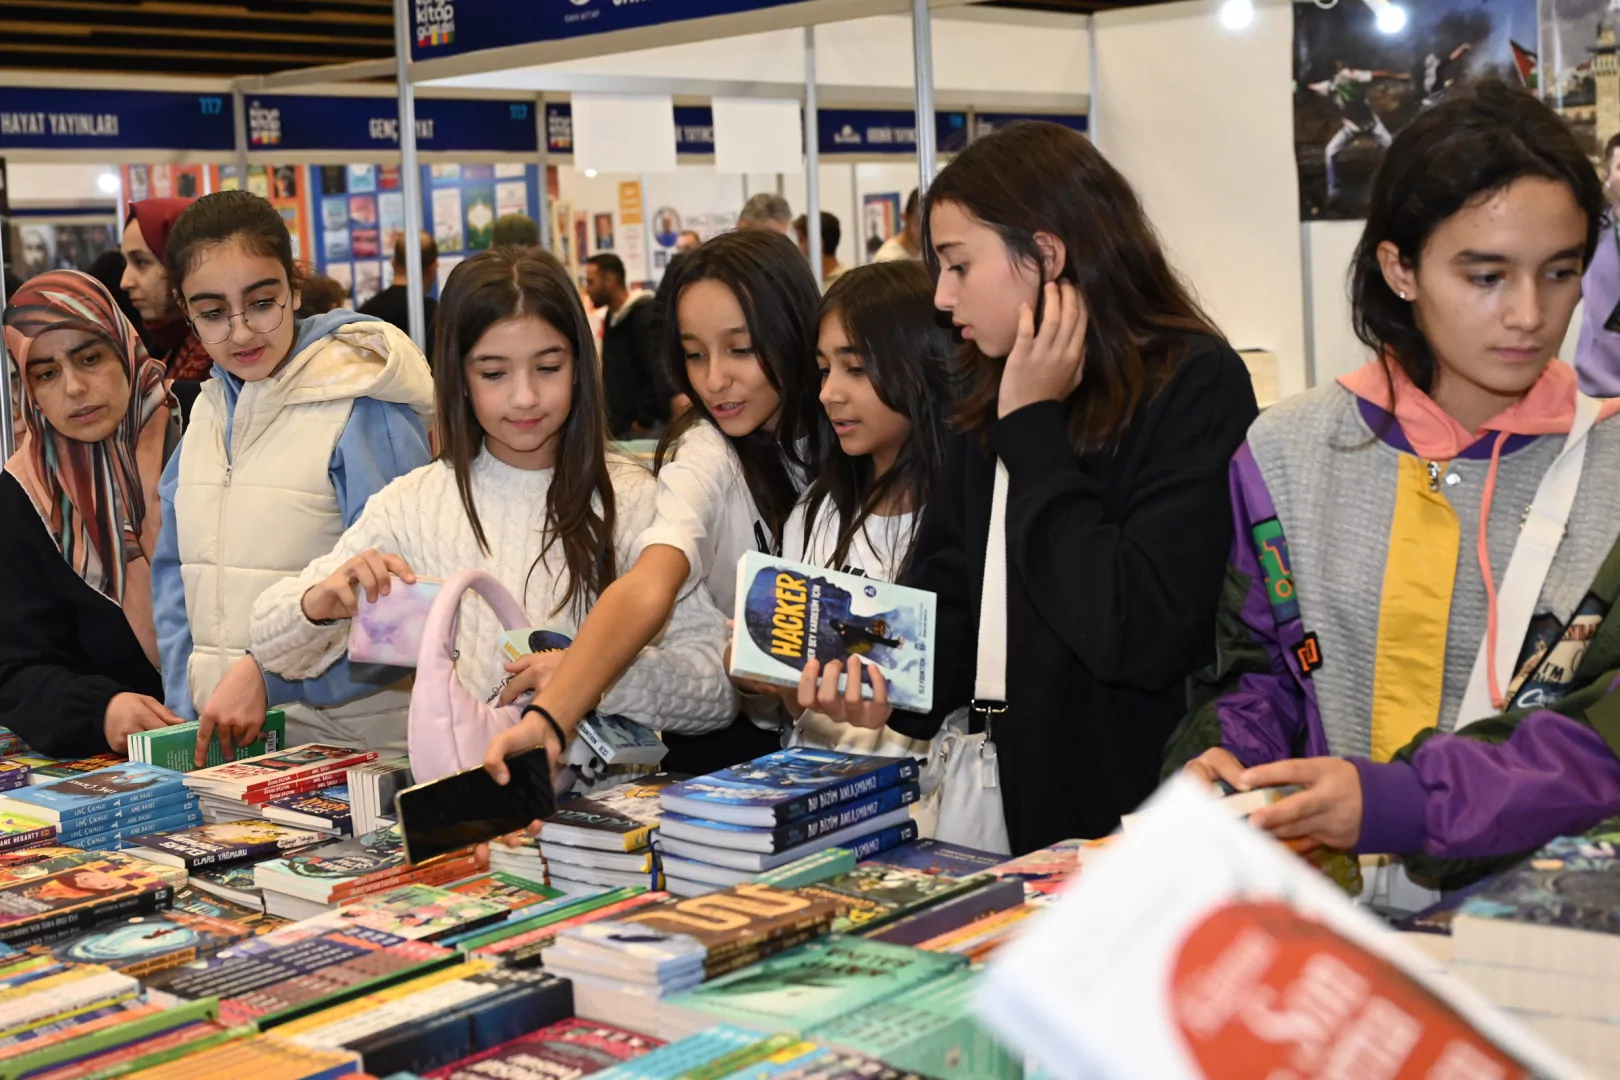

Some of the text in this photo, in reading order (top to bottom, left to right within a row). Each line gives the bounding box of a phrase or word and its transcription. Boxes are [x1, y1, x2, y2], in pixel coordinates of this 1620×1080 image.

[199, 97, 222, 114] 117
[1, 113, 119, 136] HAYAT YAYINLARI
[369, 118, 399, 143] GENÇ
[771, 573, 807, 658] HACKER
[807, 796, 818, 812] BU
[13, 831, 39, 843] HEGARTY
[807, 822, 818, 838] BU
[194, 849, 248, 866] ELMAS YAĞMURU
